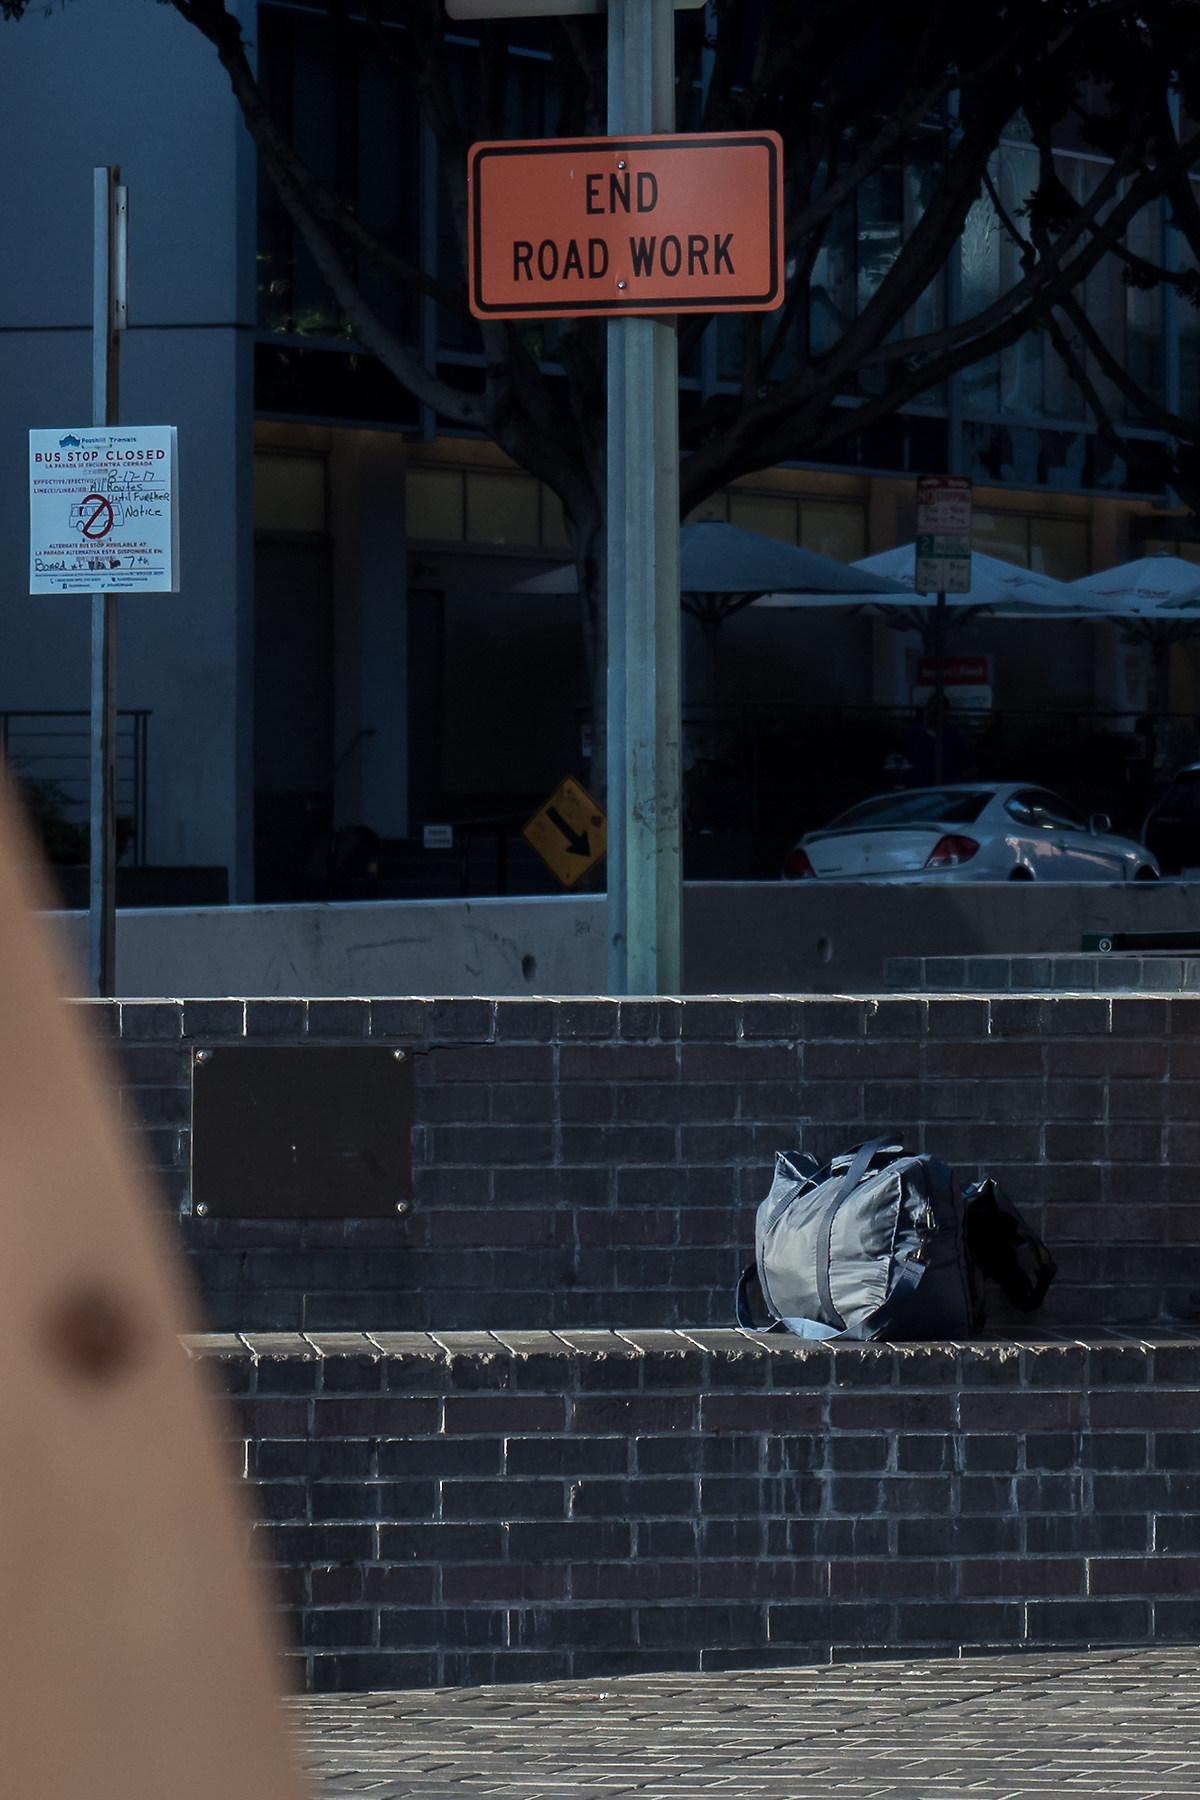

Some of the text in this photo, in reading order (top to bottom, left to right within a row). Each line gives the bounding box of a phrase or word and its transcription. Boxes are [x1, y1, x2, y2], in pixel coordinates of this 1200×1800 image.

[586, 172, 658, 214] END
[513, 233, 735, 281] ROAD WORK
[35, 450, 165, 462] BUS STOP CLOSED
[88, 481, 142, 492] All Routes
